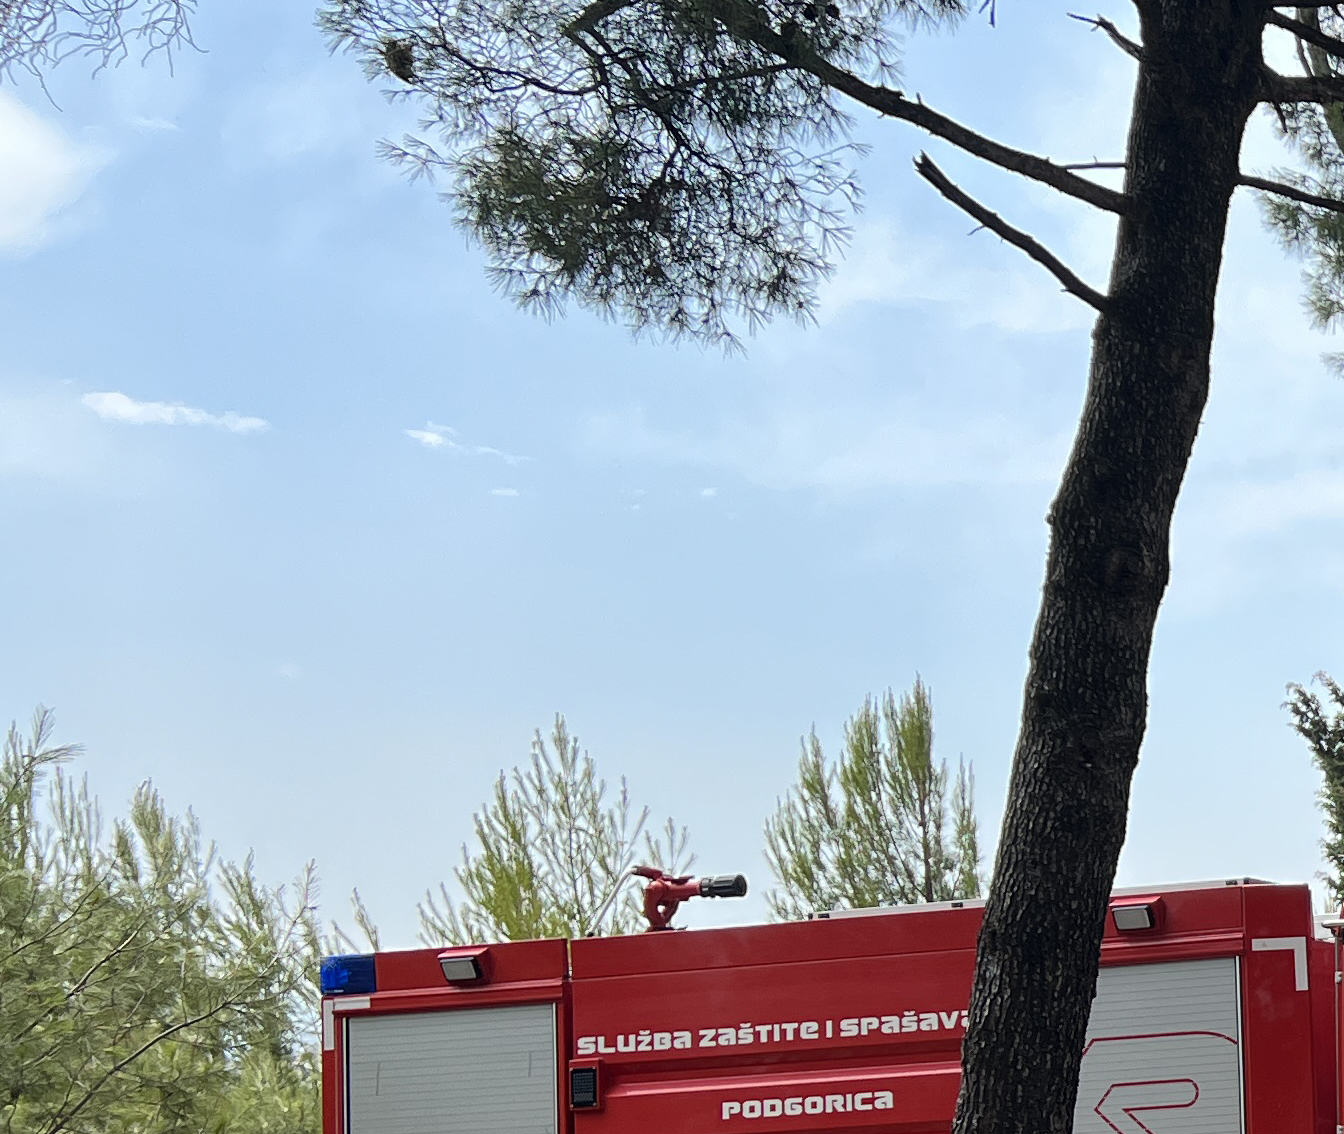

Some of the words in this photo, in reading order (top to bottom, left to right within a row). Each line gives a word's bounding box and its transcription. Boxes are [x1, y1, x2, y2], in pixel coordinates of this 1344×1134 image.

[577, 1030, 692, 1055] SLUŽBA
[699, 1020, 820, 1047] ZAŠTITE
[825, 1018, 833, 1038] I
[722, 1090, 894, 1121] PODGORICA
